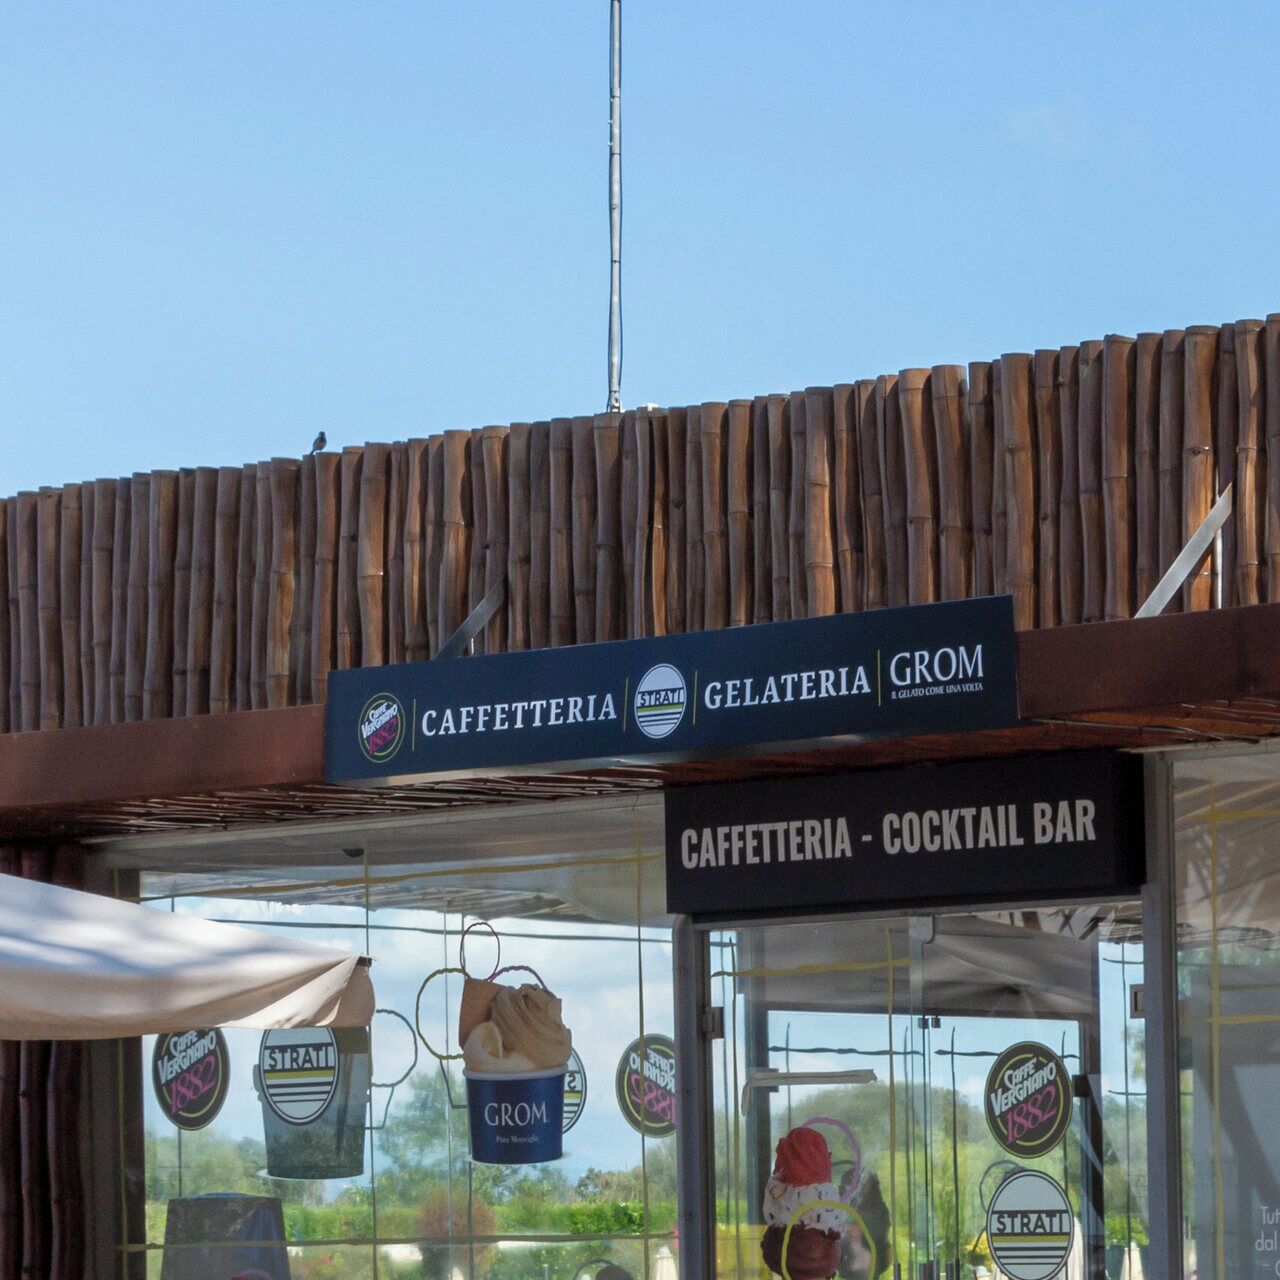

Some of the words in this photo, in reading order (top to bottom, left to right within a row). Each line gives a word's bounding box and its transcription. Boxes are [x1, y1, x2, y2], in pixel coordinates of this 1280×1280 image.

[890, 644, 984, 686] GROM
[639, 688, 685, 707] STRATI
[704, 665, 872, 710] GELATERIA
[422, 693, 617, 737] CAFFETTERIA
[681, 817, 853, 869] CAFFETTERIA
[883, 804, 1024, 855] COCKTAIL
[1033, 799, 1096, 844] BAR
[157, 1029, 217, 1084] VERGNANO
[269, 1046, 333, 1070] STRATI
[168, 1055, 217, 1115] 1882
[990, 1062, 1057, 1116] VERGNANO
[484, 1102, 548, 1127] GROM
[1005, 1085, 1057, 1144] 1882
[996, 1212, 1064, 1234] STRATI
[1255, 1232, 1278, 1252] dal
